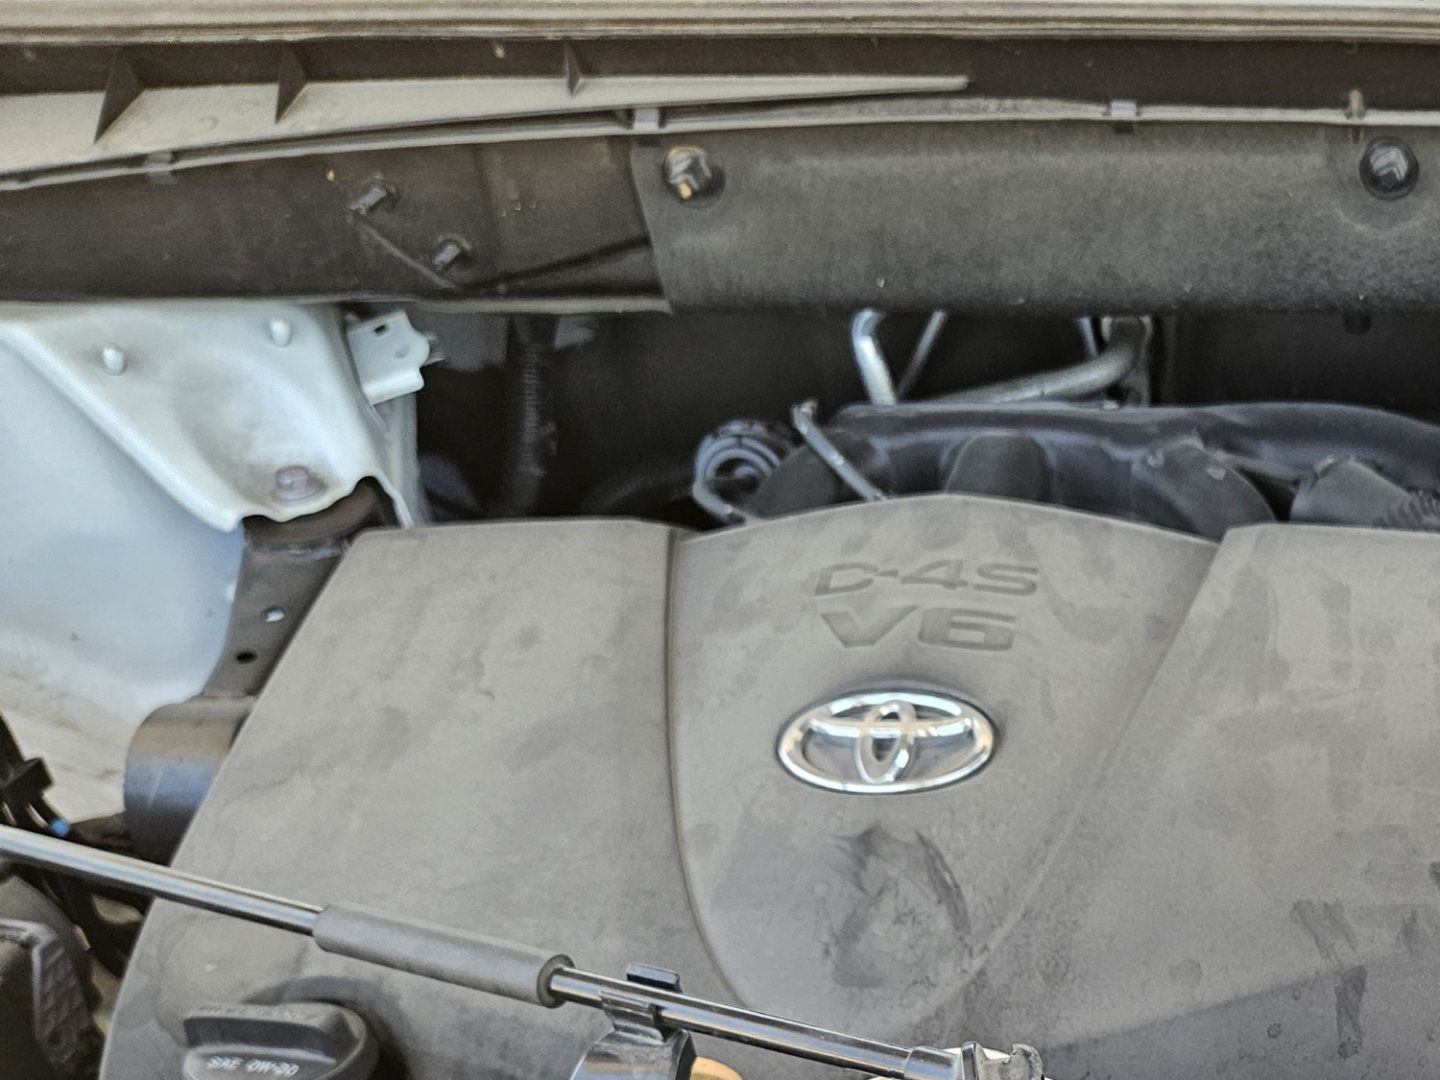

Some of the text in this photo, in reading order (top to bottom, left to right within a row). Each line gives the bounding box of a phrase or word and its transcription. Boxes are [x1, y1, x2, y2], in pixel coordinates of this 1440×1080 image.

[820, 605, 1017, 651] V6
[207, 1056, 299, 1077] SAE 0W-20
